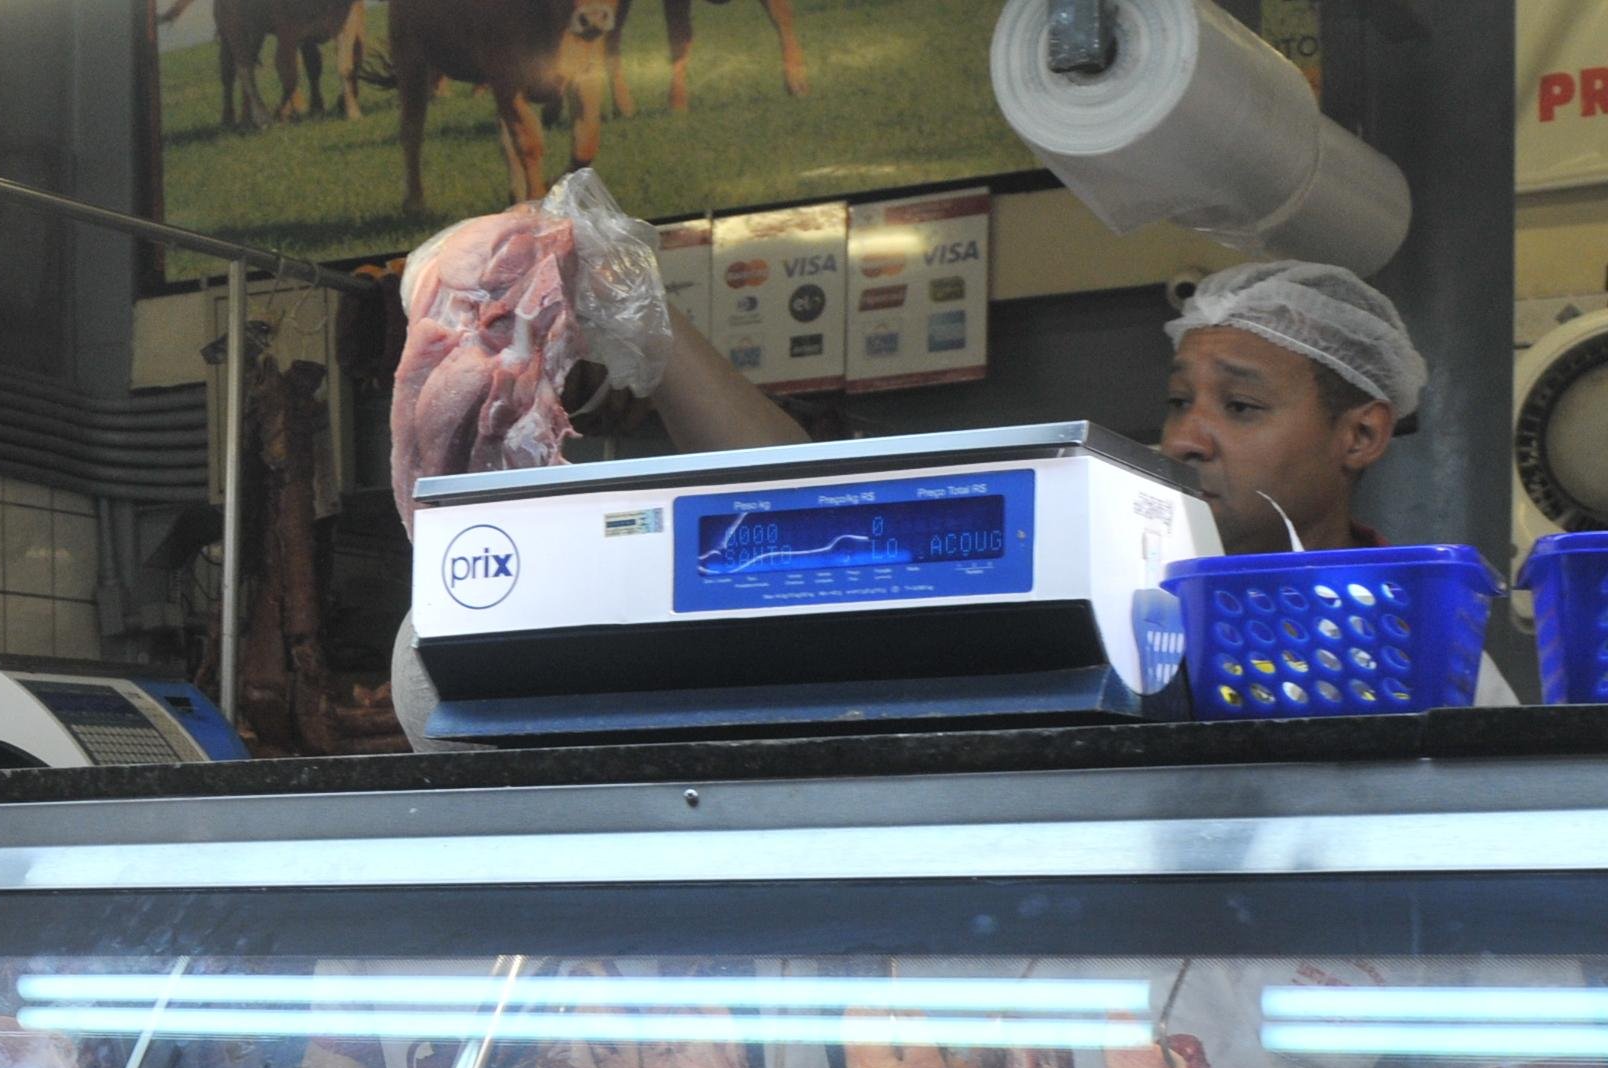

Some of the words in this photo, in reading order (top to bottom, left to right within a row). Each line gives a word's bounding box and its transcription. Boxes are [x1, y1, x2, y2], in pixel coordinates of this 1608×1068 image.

[782, 253, 837, 278] VISA
[922, 240, 979, 266] VISA
[917, 488, 945, 499] Preço
[947, 485, 970, 496] Total
[451, 547, 513, 588] prix
